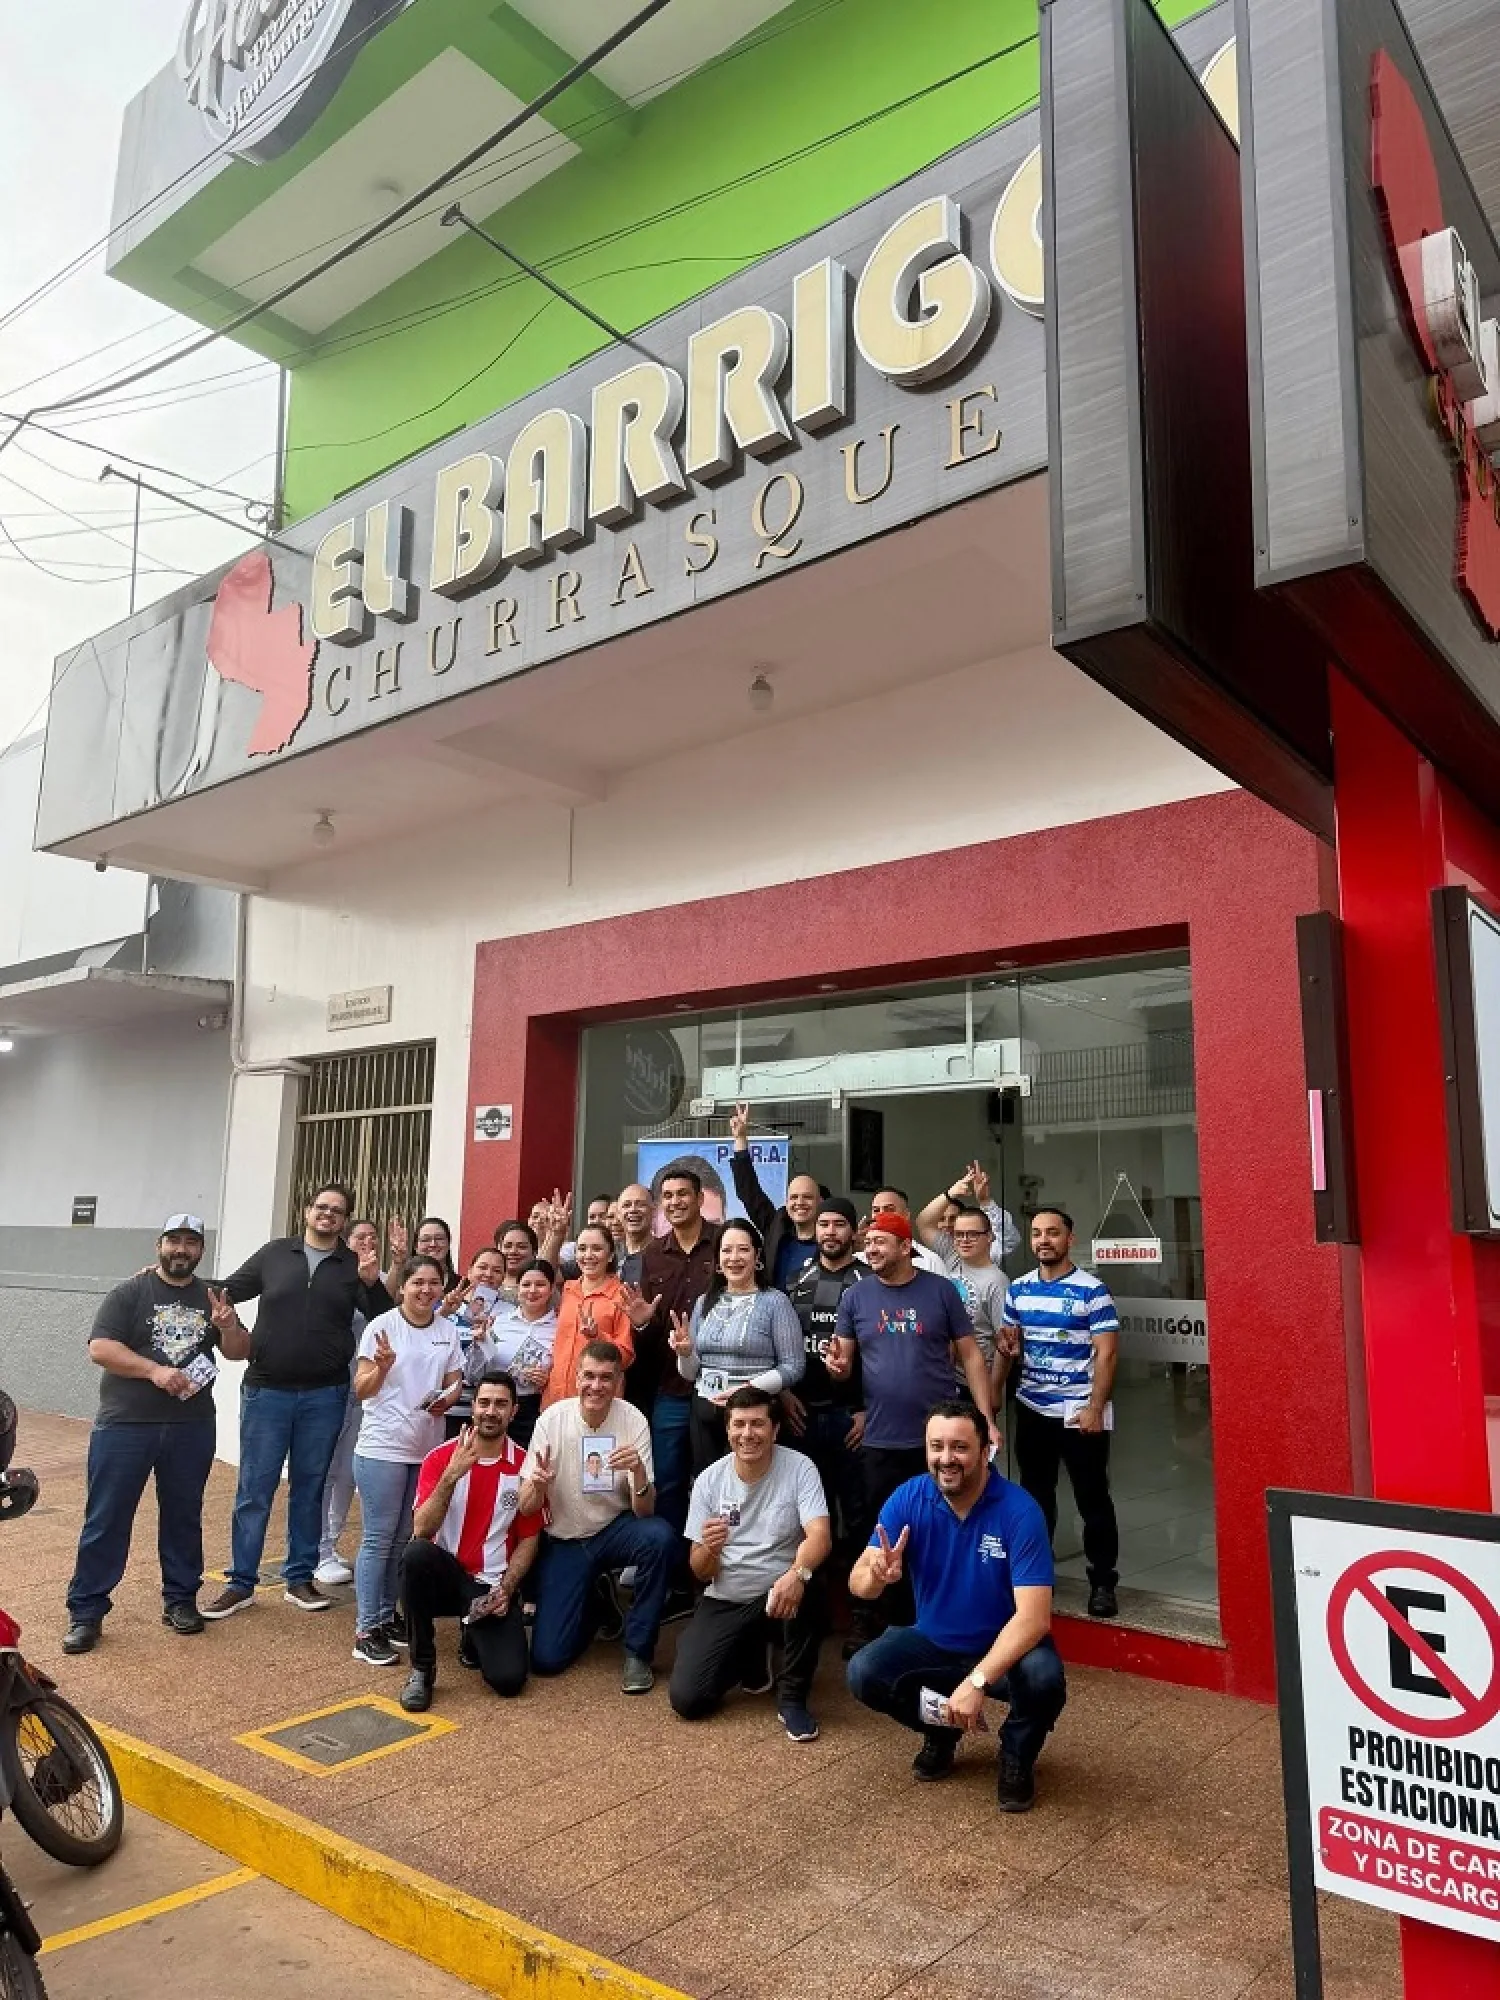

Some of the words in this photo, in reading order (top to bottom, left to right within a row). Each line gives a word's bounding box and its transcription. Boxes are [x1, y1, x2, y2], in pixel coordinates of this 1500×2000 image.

[325, 384, 1002, 717] CHURRASQUE
[1095, 1247, 1157, 1259] CERRADO
[1348, 1725, 1500, 1795] PROHIBIDO
[1340, 1766, 1500, 1841] ESTACIONA
[1327, 1815, 1401, 1855] ZONA
[1406, 1837, 1441, 1865] DE
[1352, 1851, 1369, 1873] Y
[1376, 1857, 1499, 1911] DESCARG
